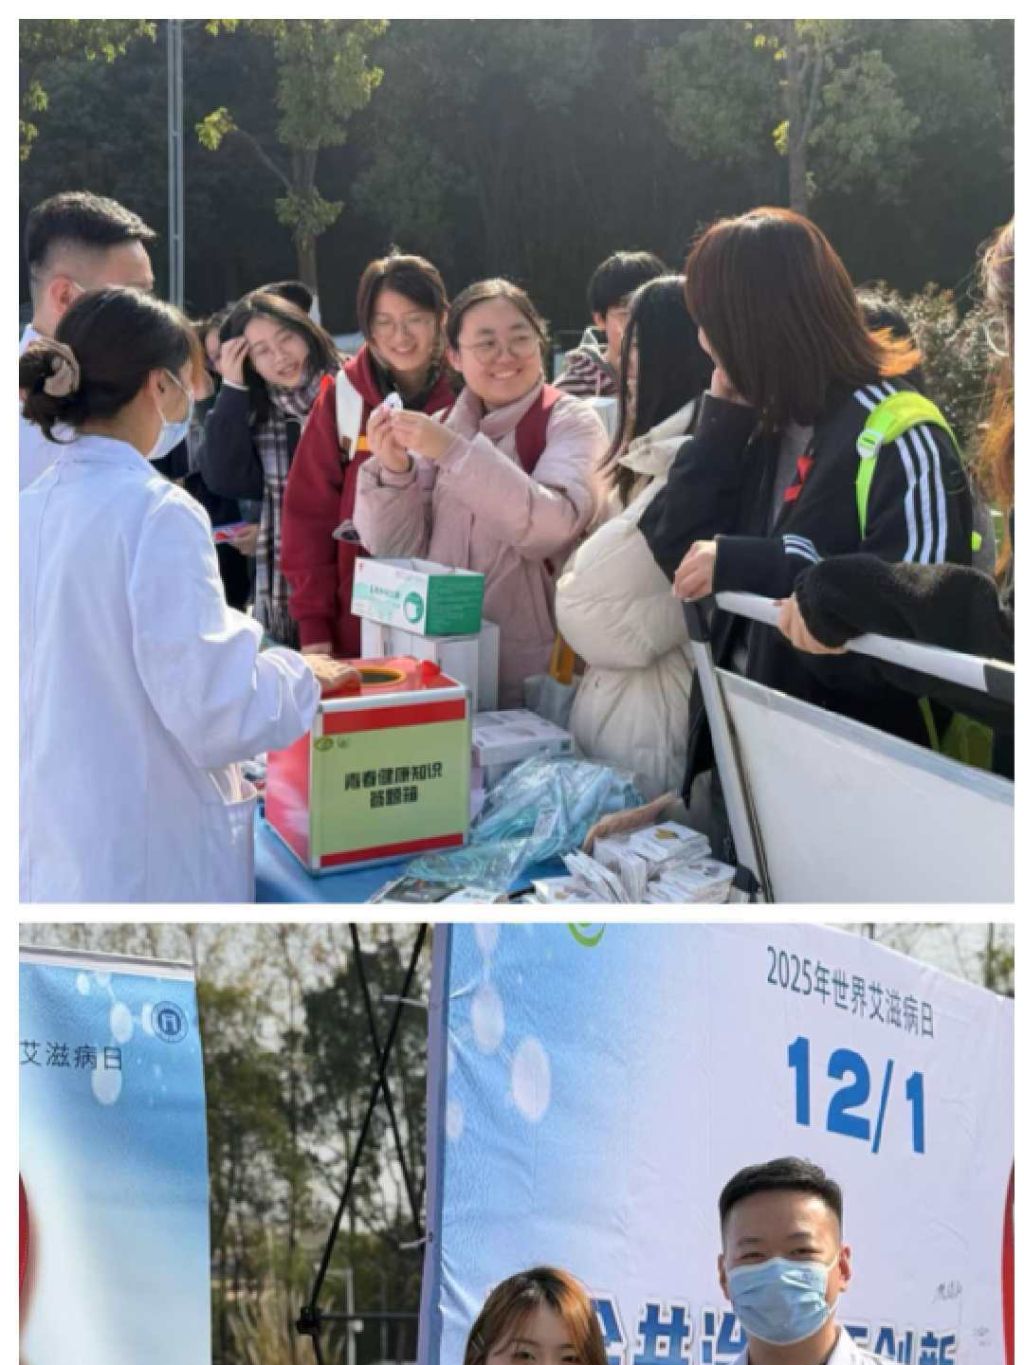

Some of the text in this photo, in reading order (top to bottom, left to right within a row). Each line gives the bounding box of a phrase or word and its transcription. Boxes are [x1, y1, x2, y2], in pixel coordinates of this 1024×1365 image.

[345, 761, 443, 791] 青春健康知识
[370, 785, 418, 808] 答题箱
[767, 945, 934, 1038] 2025年世界艾滋病日
[19, 1040, 122, 1071] 艾滋病日
[787, 1035, 926, 1154] 12/1
